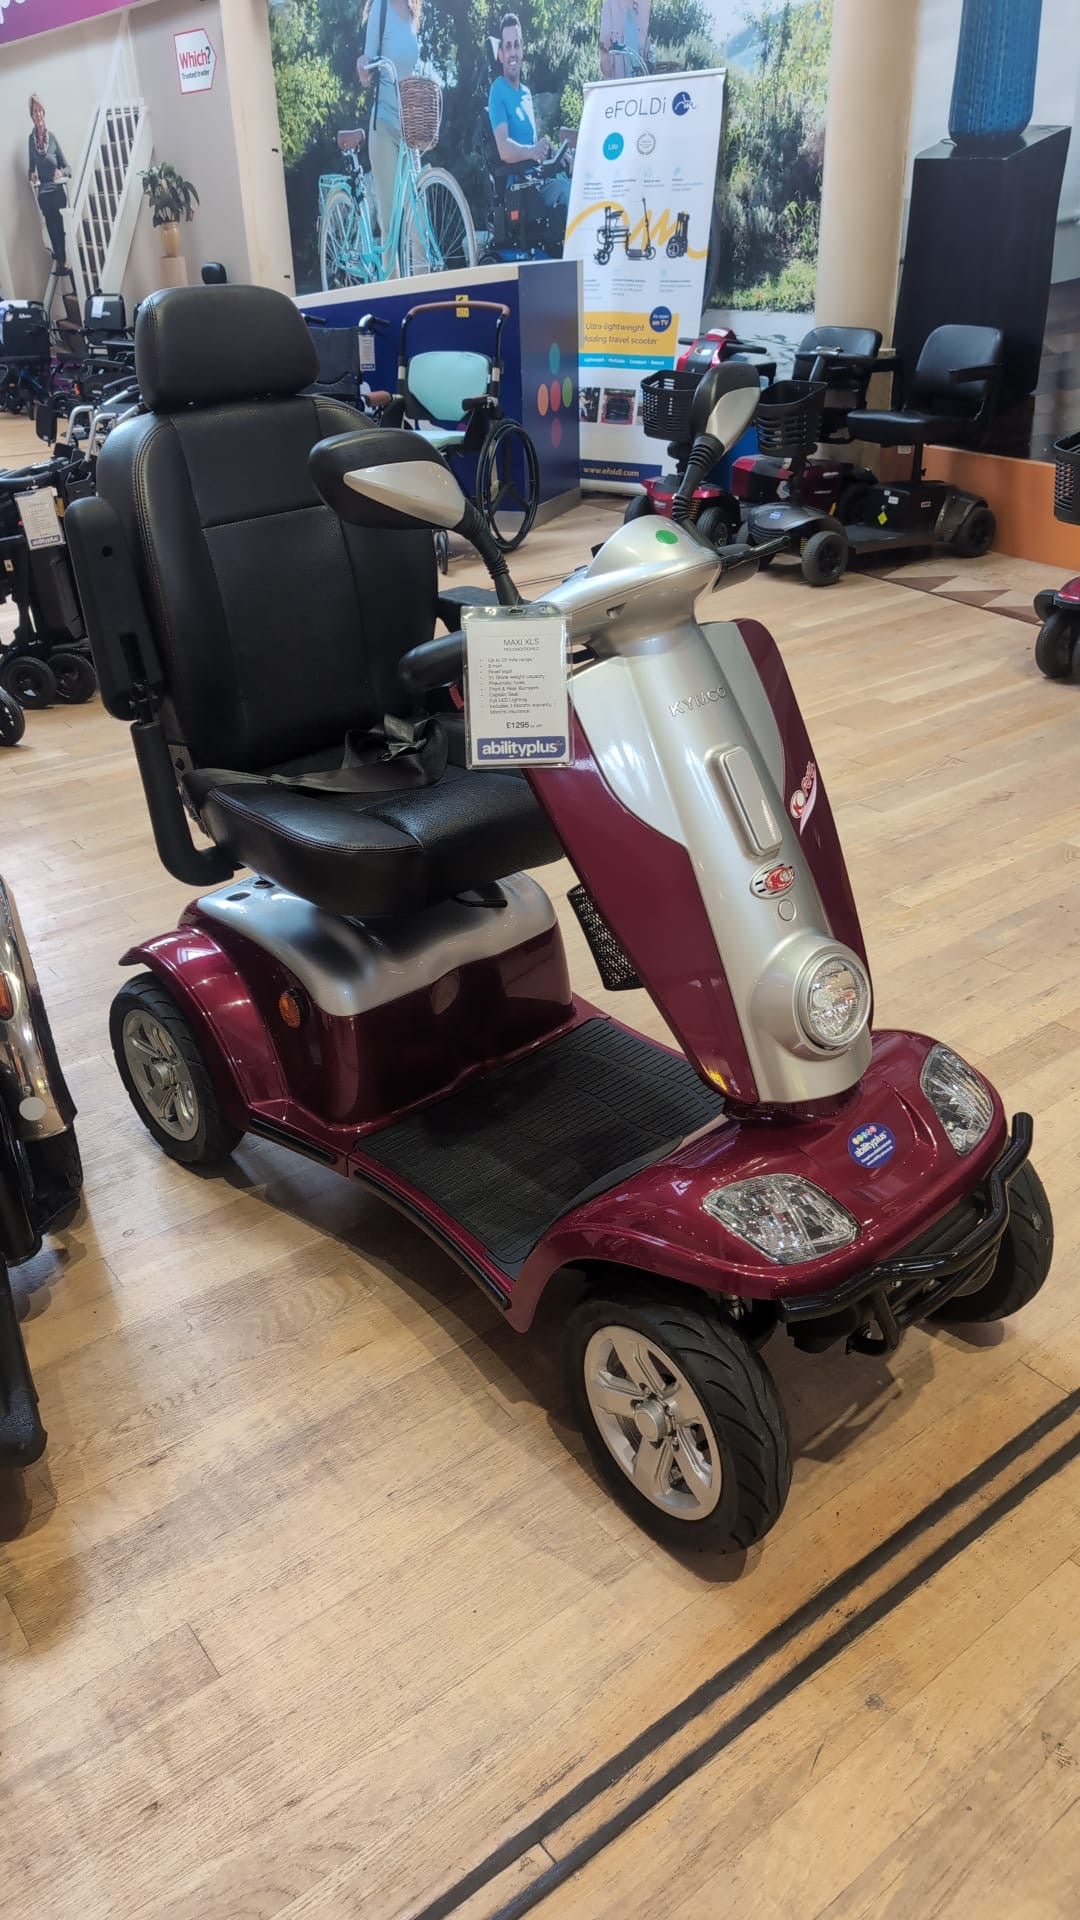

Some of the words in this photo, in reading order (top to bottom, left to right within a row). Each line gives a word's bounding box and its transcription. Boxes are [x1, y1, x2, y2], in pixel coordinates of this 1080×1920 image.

[179, 46, 211, 69] Which?
[605, 97, 666, 119] eFOLDi
[609, 335, 630, 344] travel
[631, 337, 657, 345] scooter
[525, 637, 540, 645] XLS
[669, 687, 727, 717] KYMCO
[506, 721, 530, 729] £1295
[482, 740, 558, 757] abilityplus
